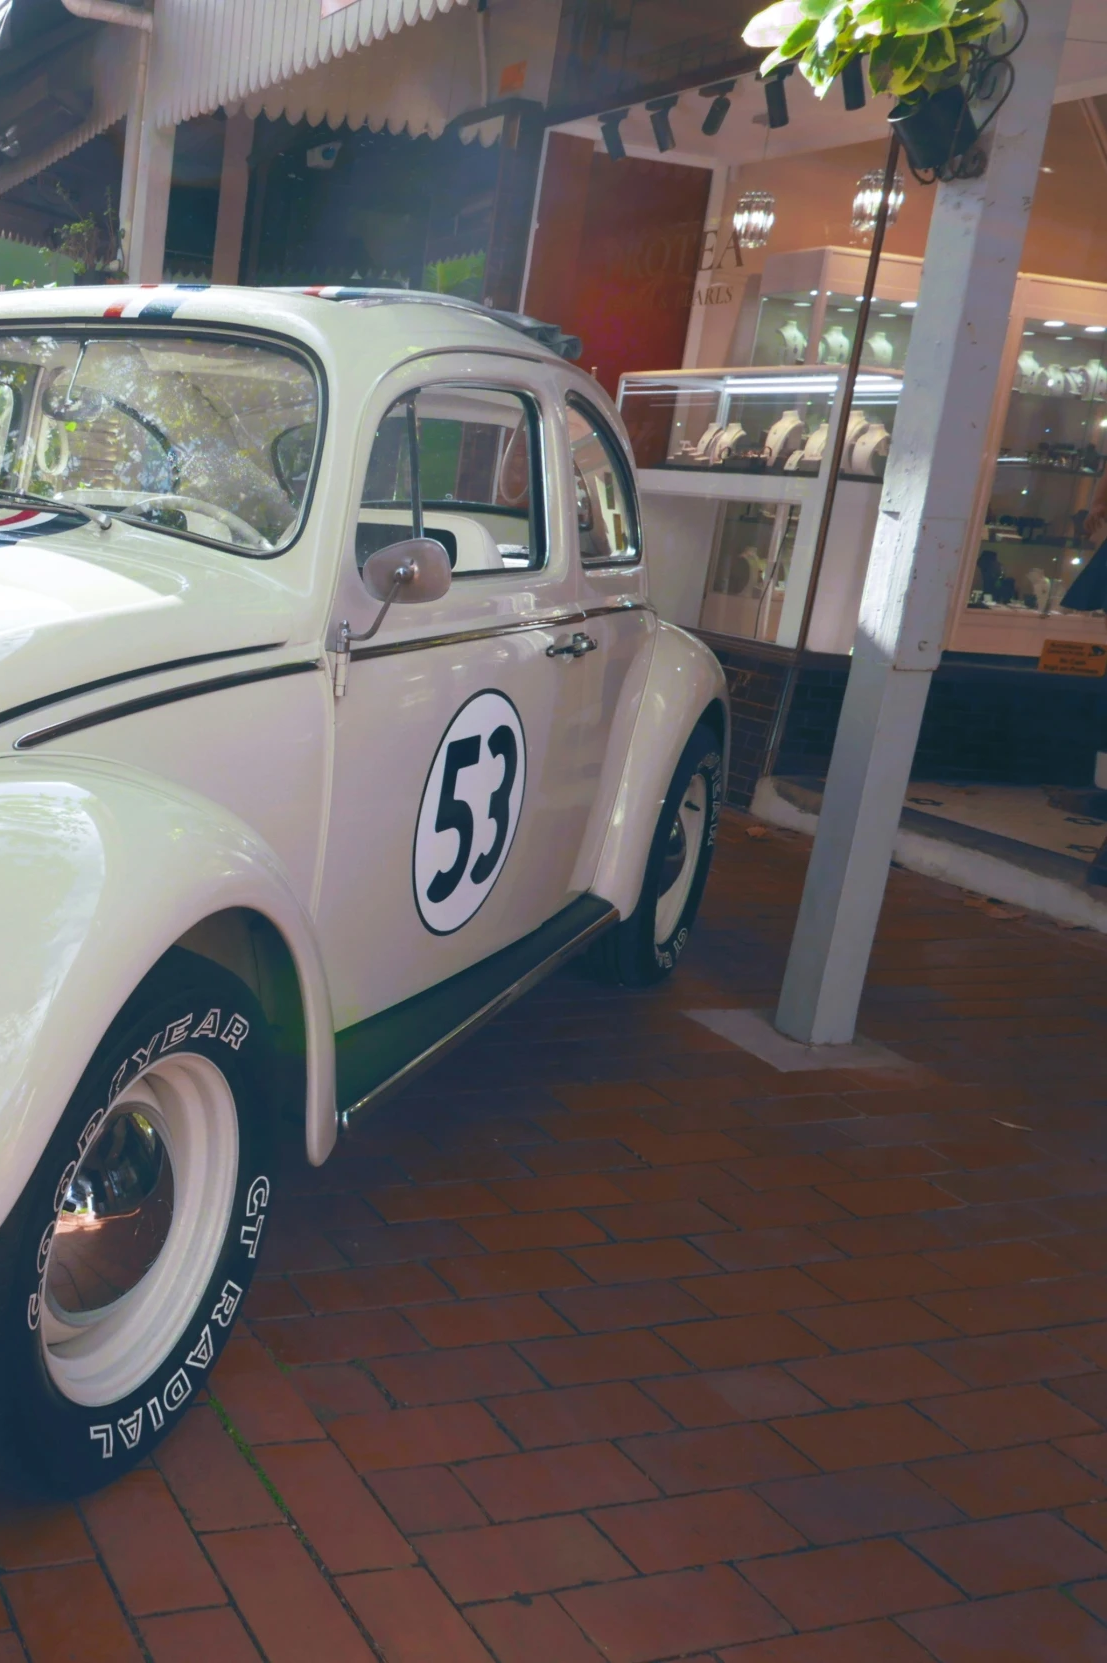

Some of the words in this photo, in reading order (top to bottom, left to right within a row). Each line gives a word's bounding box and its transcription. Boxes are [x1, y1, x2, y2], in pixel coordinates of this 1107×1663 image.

[426, 724, 518, 903] 53
[240, 1175, 271, 1259] GT
[89, 1279, 244, 1459] RADIAL
